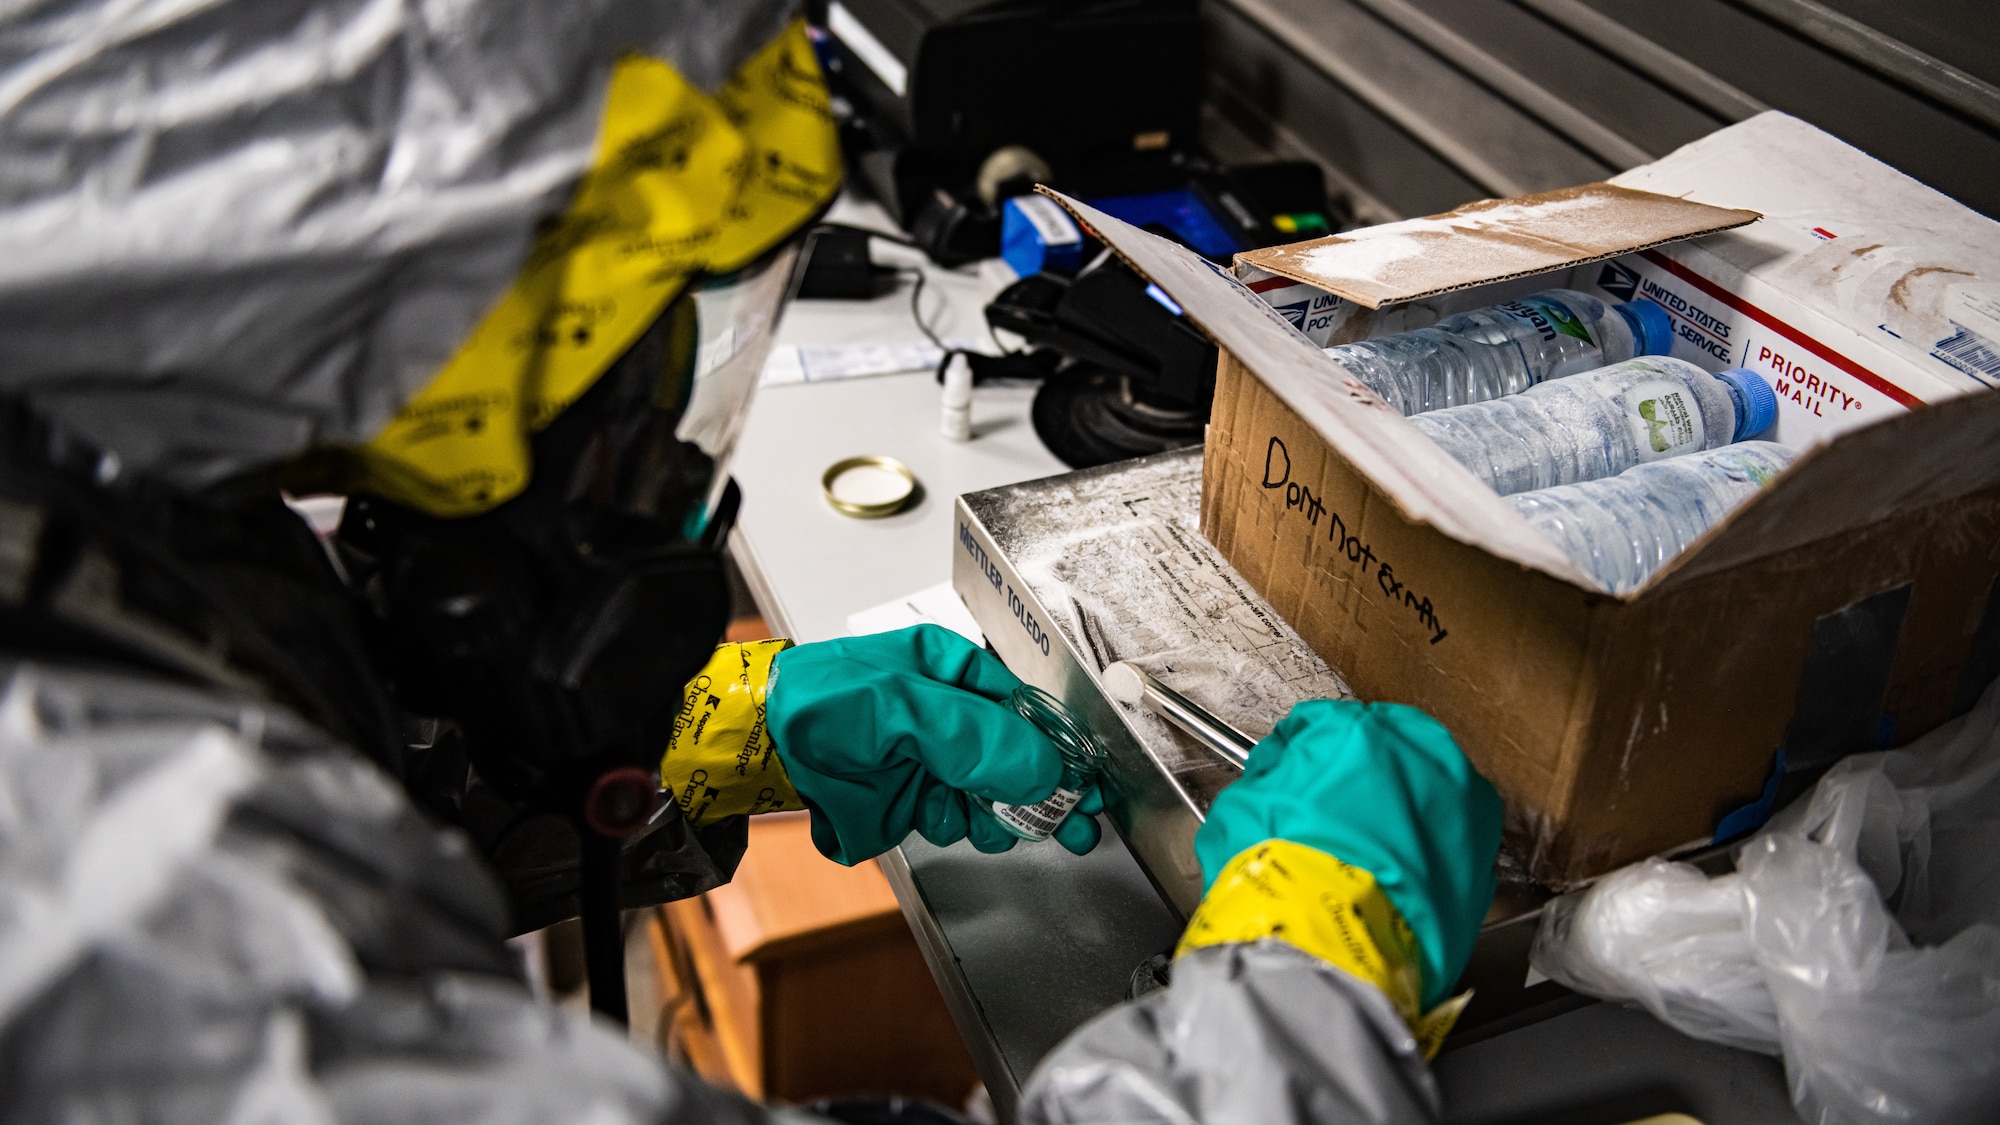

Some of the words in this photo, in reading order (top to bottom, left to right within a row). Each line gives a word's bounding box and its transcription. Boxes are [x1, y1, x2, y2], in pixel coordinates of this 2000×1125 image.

[1642, 278, 1687, 312] UNITED
[1686, 306, 1731, 338] STATES
[1776, 378, 1822, 417] MAIL
[1329, 512, 1378, 573] not
[960, 521, 1003, 596] METTLER
[1007, 583, 1050, 657] TOLEDO
[1261, 617, 1284, 640] corner
[1000, 808, 1025, 828] Container
